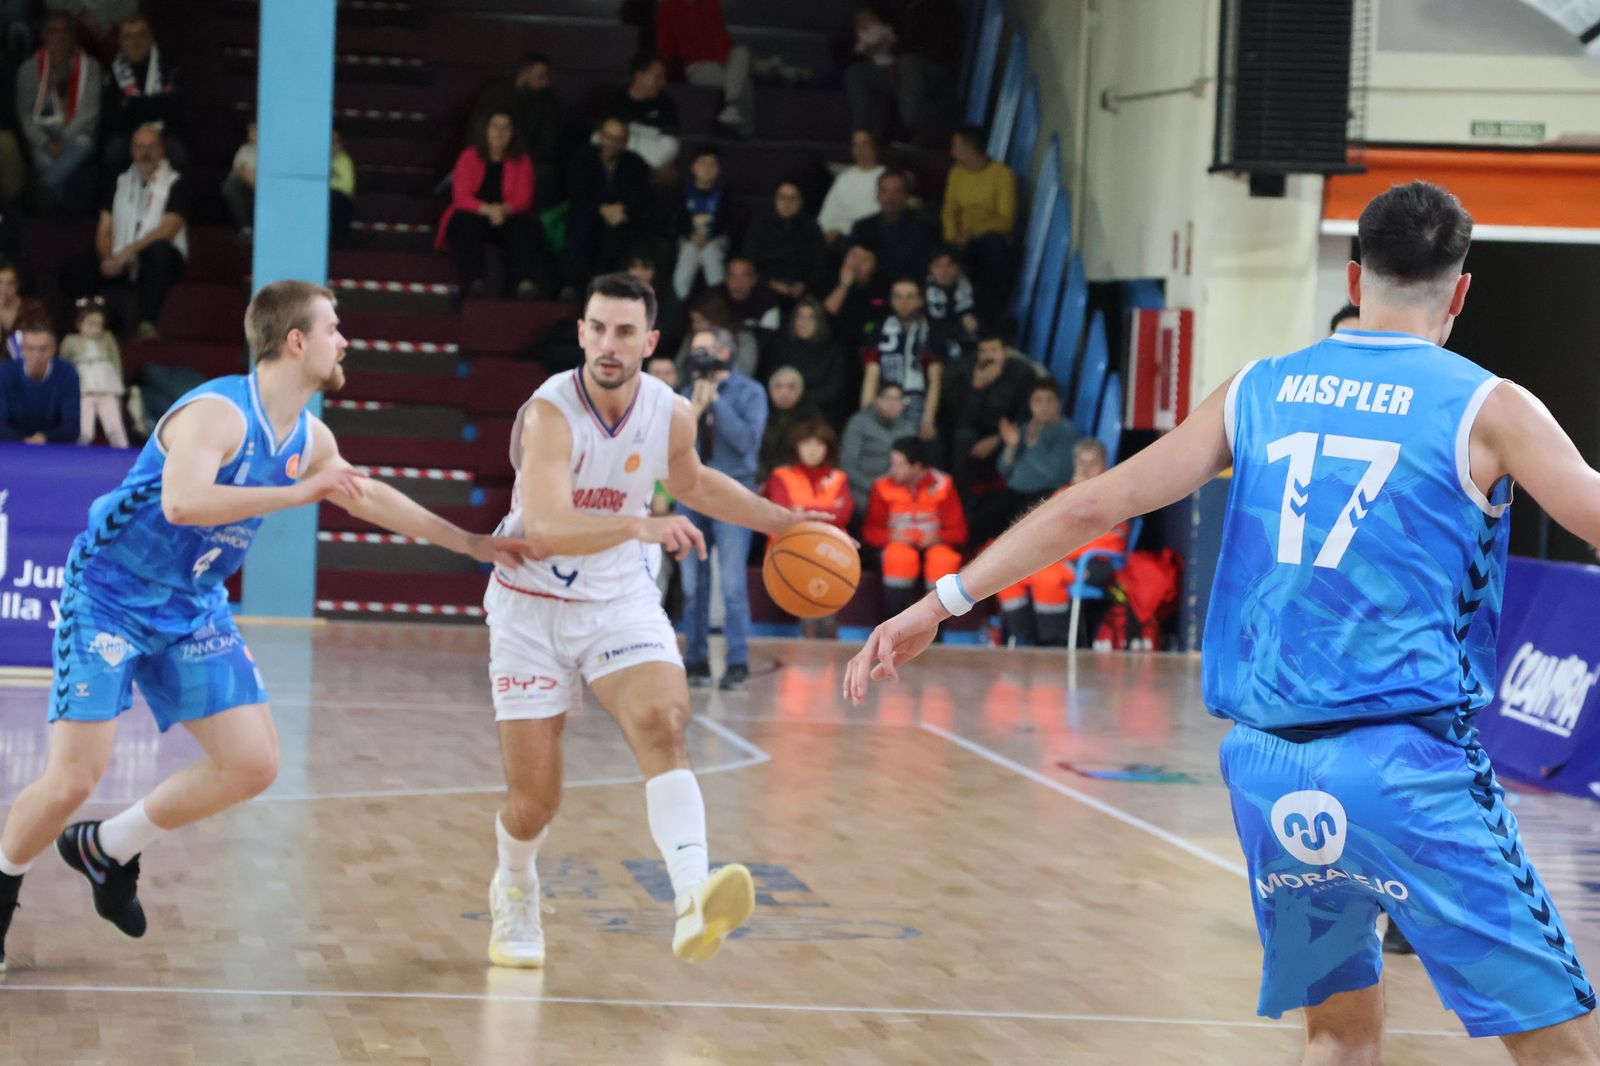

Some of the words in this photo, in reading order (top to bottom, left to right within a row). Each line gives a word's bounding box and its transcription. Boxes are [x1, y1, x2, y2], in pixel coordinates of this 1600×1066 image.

[1275, 374, 1414, 416] NASPLER
[1266, 431, 1401, 569] 17
[1255, 868, 1409, 901] MORAEJO
